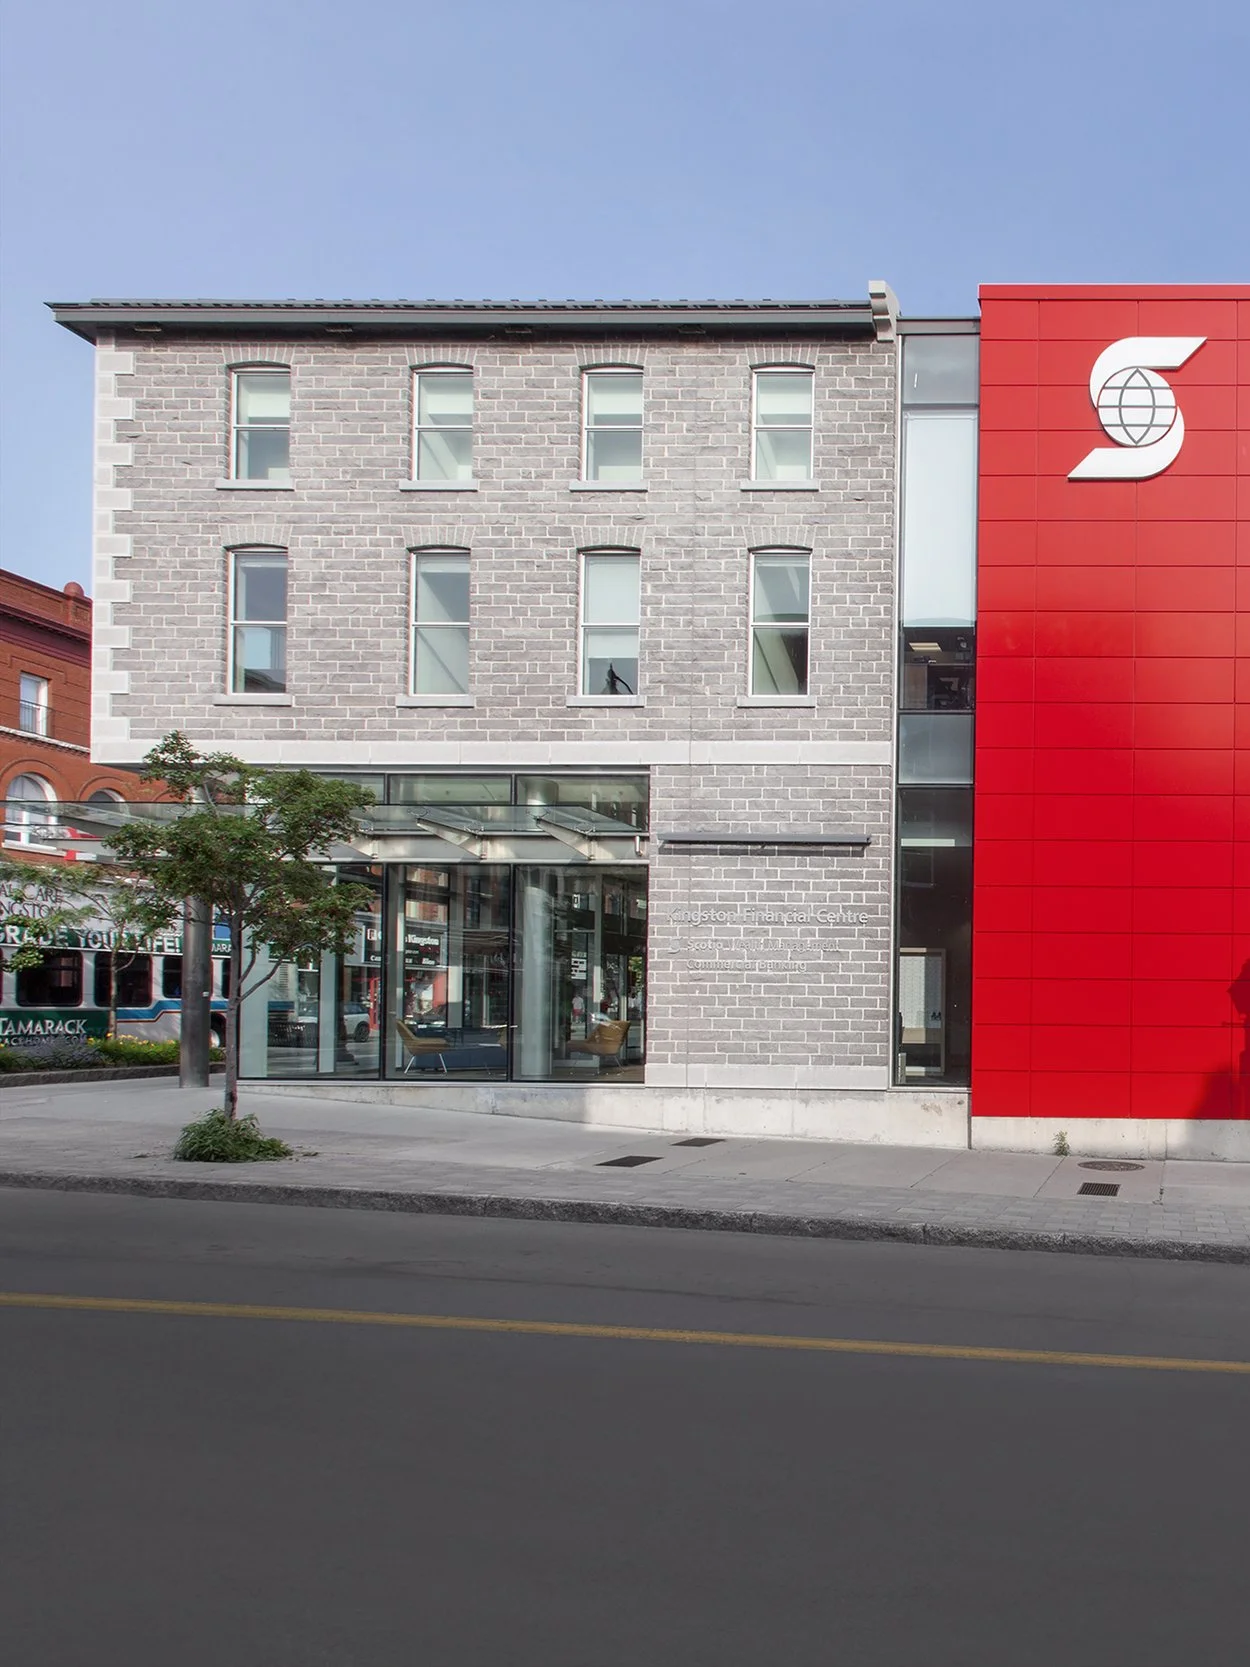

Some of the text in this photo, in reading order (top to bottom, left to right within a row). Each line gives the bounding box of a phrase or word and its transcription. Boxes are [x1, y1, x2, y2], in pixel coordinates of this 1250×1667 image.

[23, 883, 63, 903] CARE
[666, 907, 869, 926] Kingston Financial Centre
[768, 939, 839, 953] Management
[686, 959, 807, 972] Commercial Banking
[0, 1017, 88, 1036] TAMARACK
